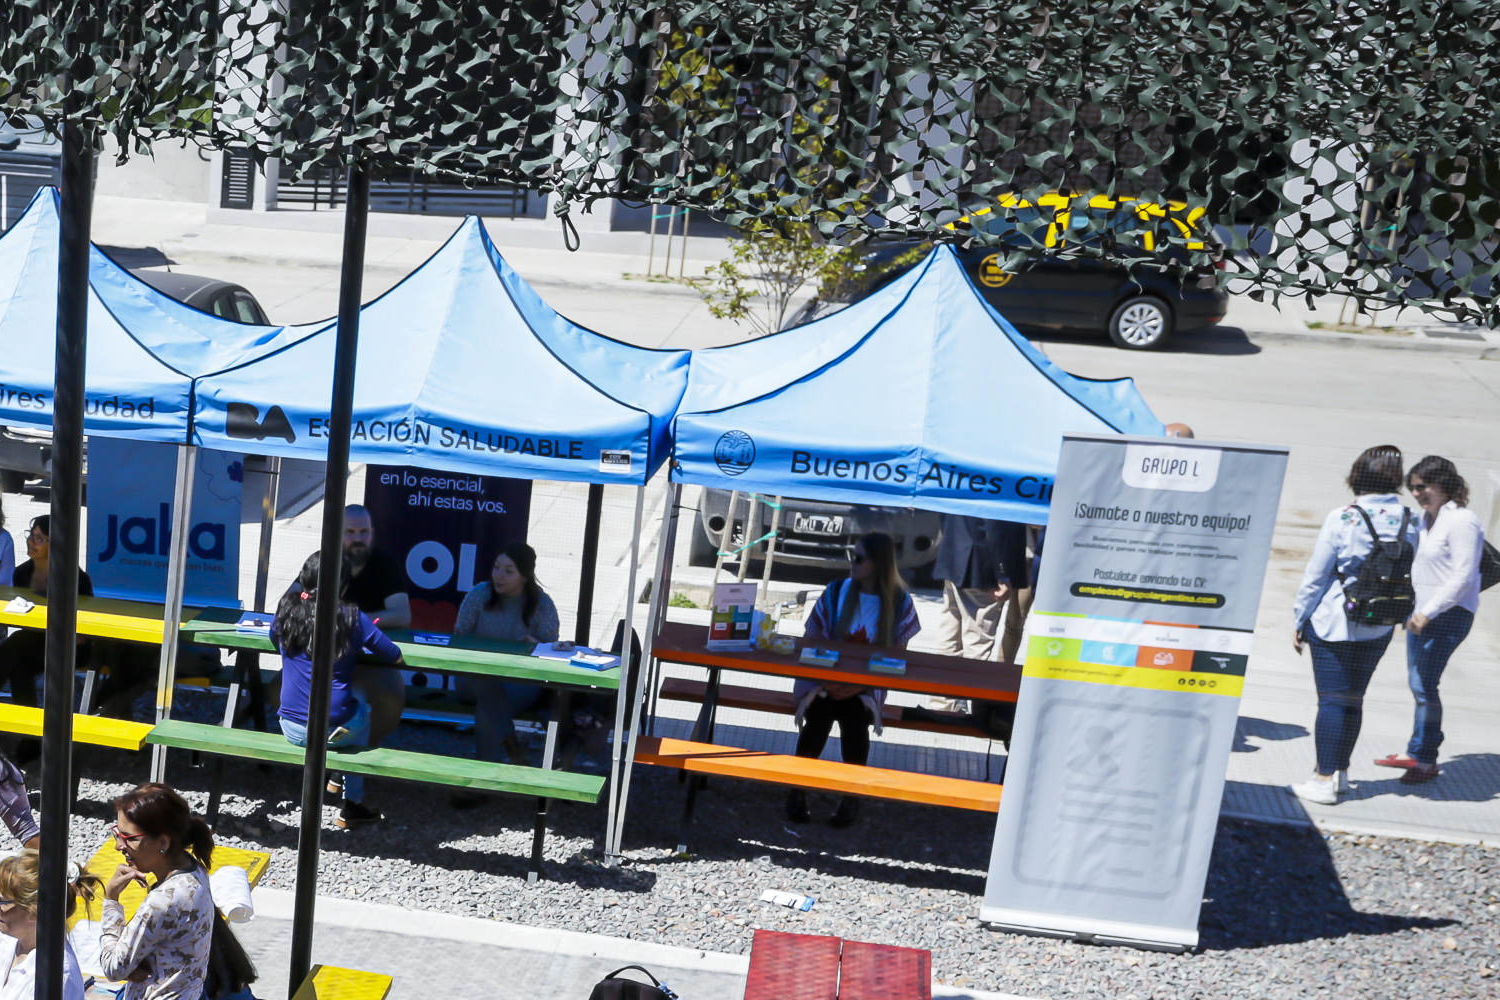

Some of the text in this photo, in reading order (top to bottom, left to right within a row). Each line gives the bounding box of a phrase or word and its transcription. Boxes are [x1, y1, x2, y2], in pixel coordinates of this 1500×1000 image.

[84, 395, 154, 419] udad
[308, 417, 431, 446] ESACIÓN
[439, 427, 583, 460] SALUDABLE
[791, 450, 909, 483] Buenos
[921, 462, 1003, 495] Aires
[1141, 457, 1199, 477] GRUPO L
[380, 471, 486, 495] en lo esencial,
[408, 491, 507, 514] ahí estas vos.
[796, 517, 816, 531] JKU
[1074, 503, 1252, 534] ¡Sumate a nuestro equipo!
[120, 557, 152, 567] marcas
[203, 562, 225, 573] bien
[1093, 568, 1207, 589] Postulate enviando tu CV:
